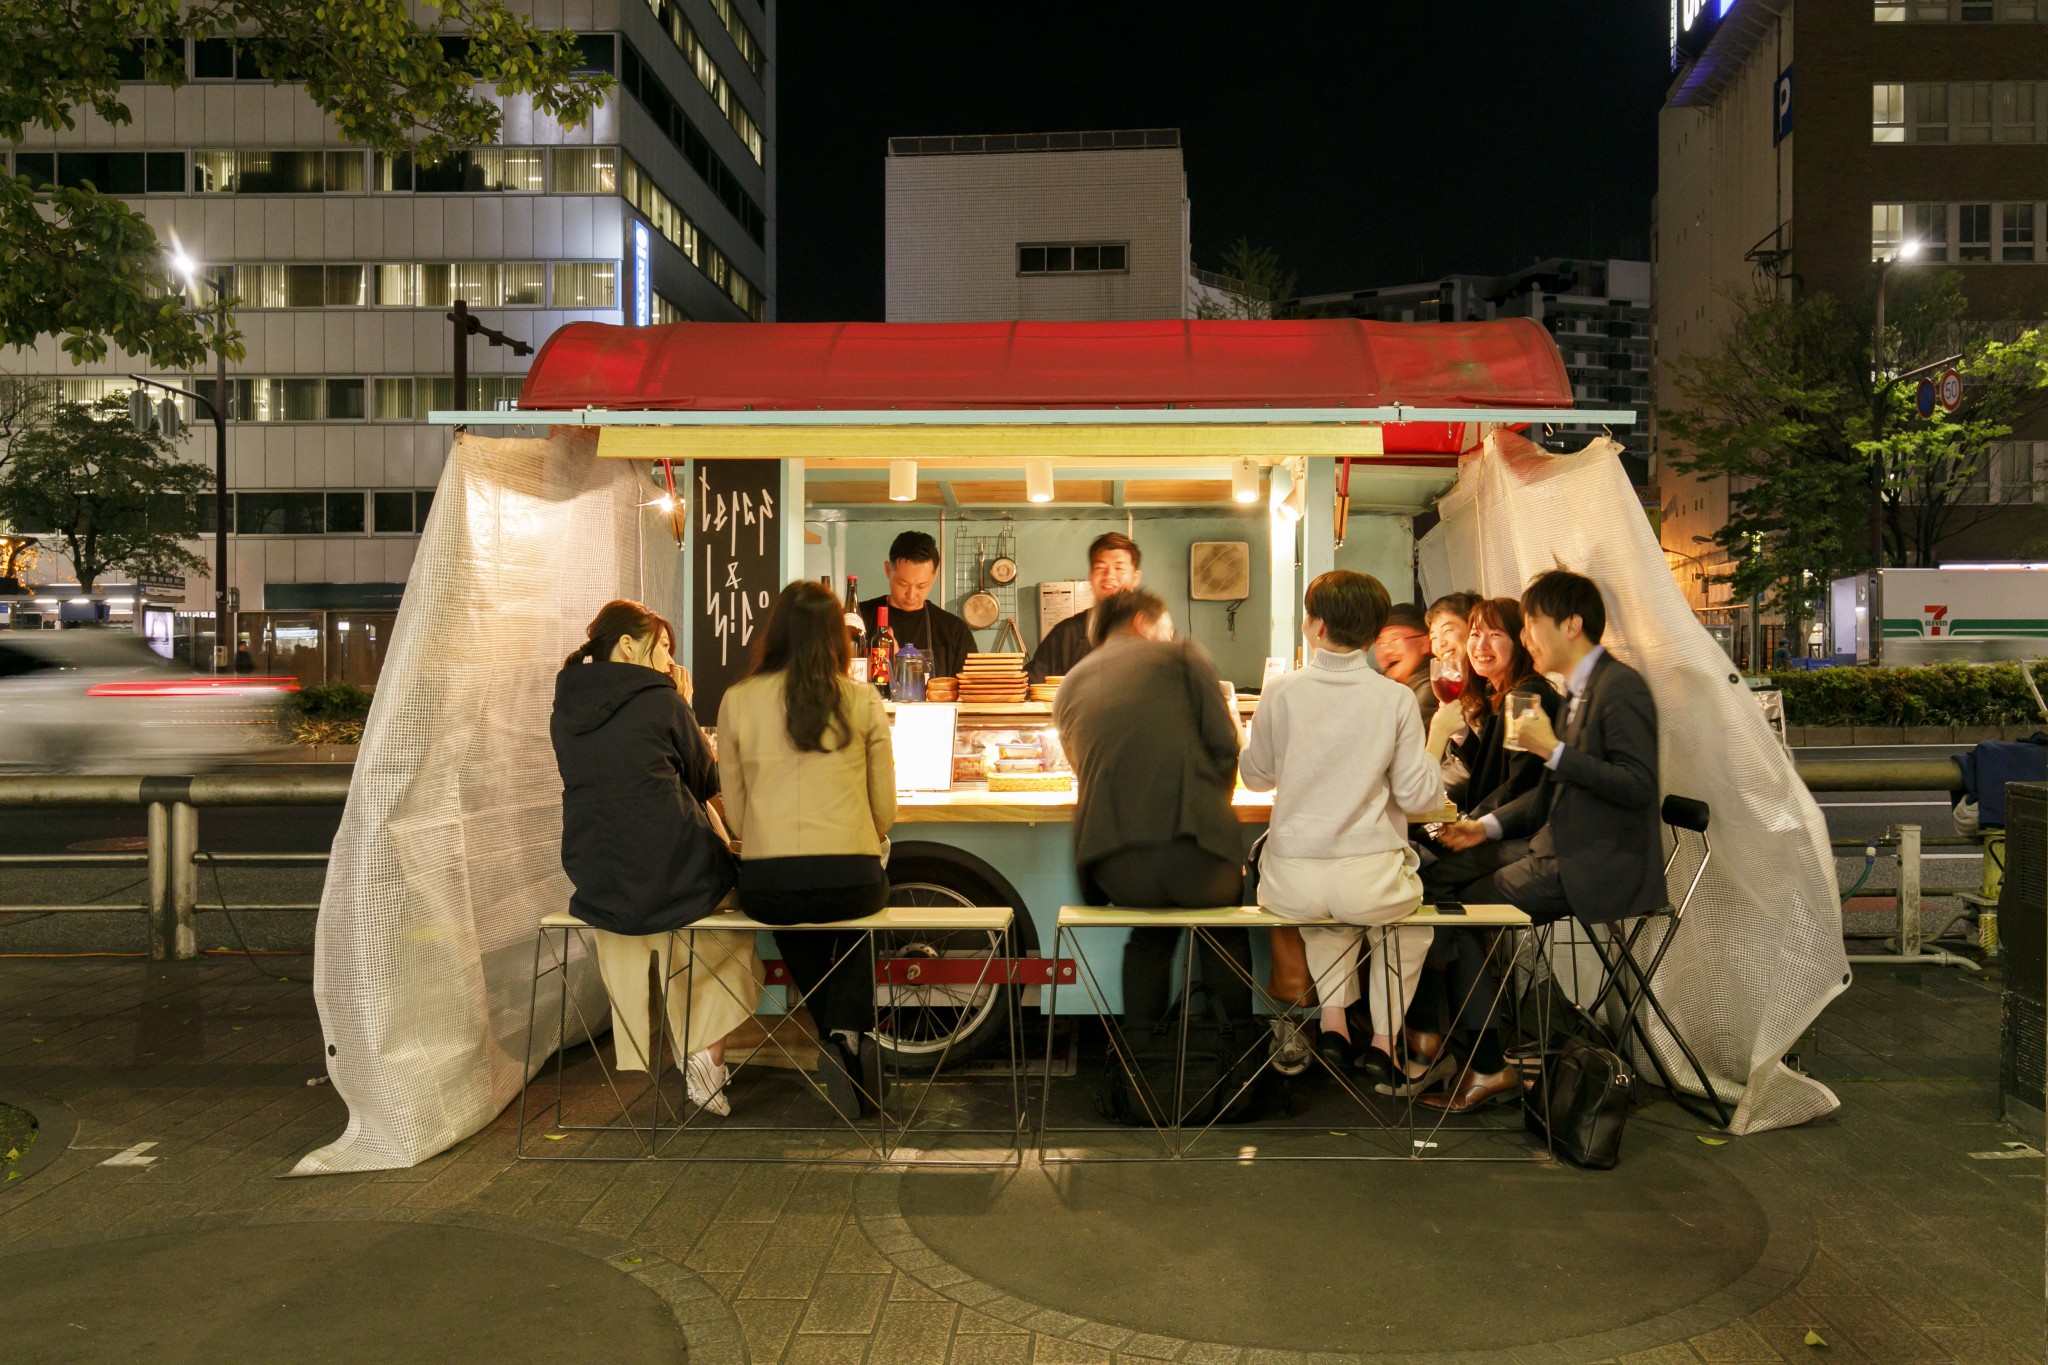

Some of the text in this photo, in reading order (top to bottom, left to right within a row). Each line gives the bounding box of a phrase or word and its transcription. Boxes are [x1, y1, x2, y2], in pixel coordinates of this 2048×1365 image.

[1779, 78, 1791, 133] P
[1945, 381, 1957, 399] 50
[1924, 605, 1948, 635] 7
